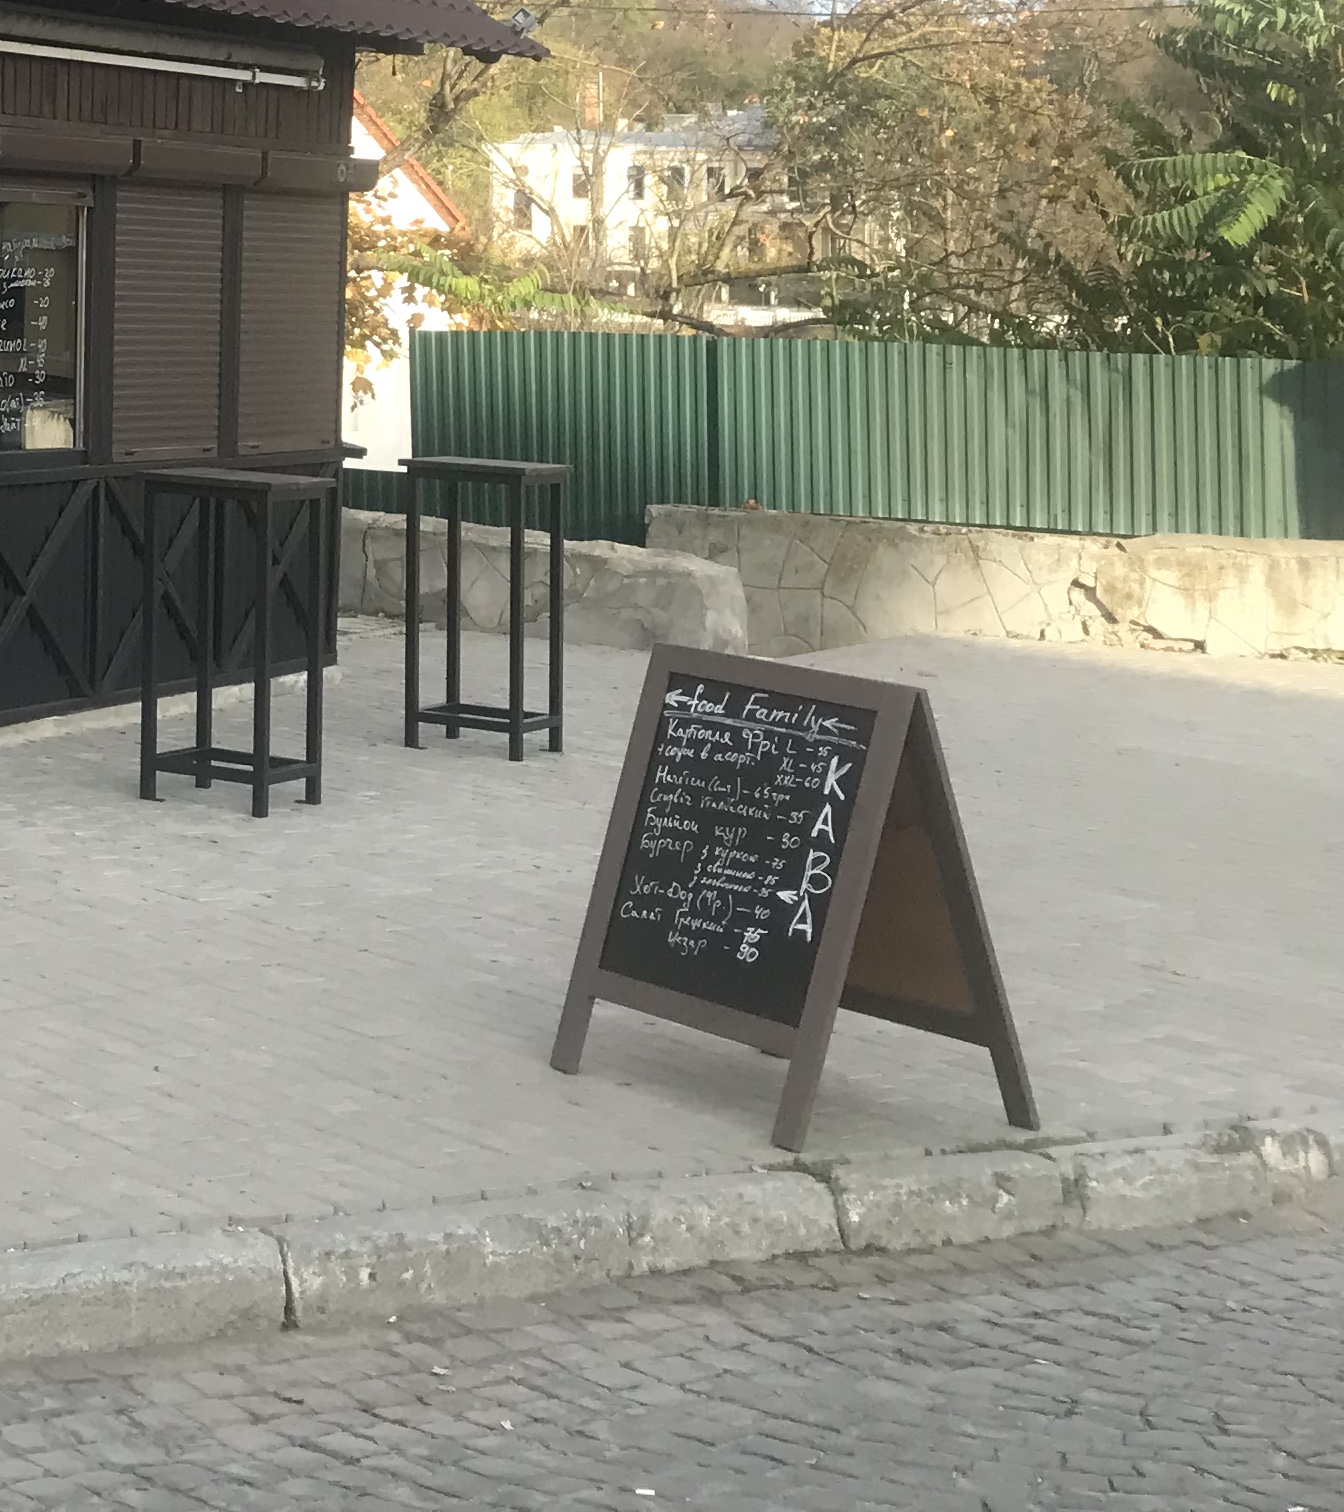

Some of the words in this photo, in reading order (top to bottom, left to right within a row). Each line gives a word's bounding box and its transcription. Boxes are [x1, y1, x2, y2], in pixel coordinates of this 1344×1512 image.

[686, 683, 726, 714] food
[742, 692, 823, 741] Family
[666, 718, 734, 747] Картопля
[644, 805, 699, 836] Бульйон
[639, 832, 694, 863] Бургер
